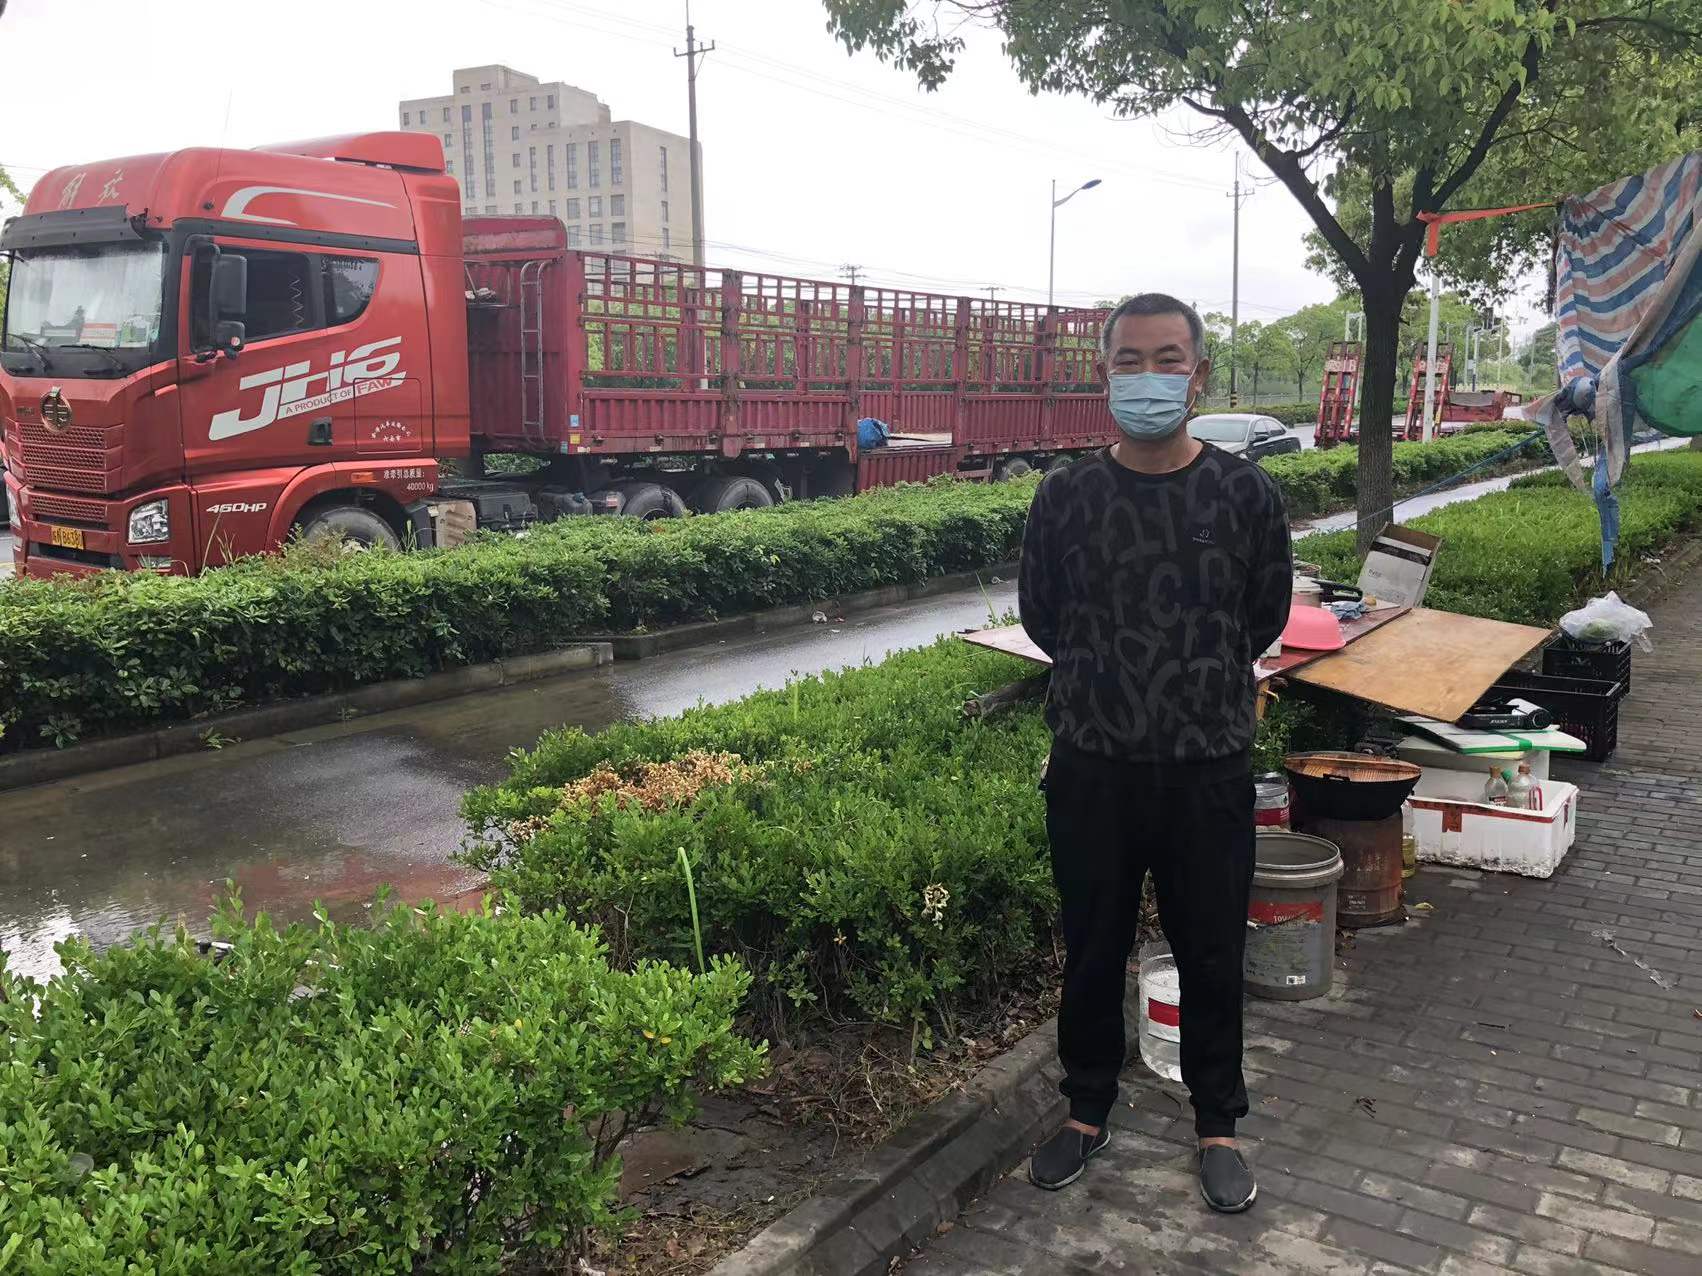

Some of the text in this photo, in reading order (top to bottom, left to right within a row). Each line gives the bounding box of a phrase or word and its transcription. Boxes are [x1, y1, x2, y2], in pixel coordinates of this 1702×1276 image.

[285, 377, 393, 415] A PRODUCT OF FAW
[406, 480, 435, 493] 40000 kg
[206, 502, 268, 513] 460HP
